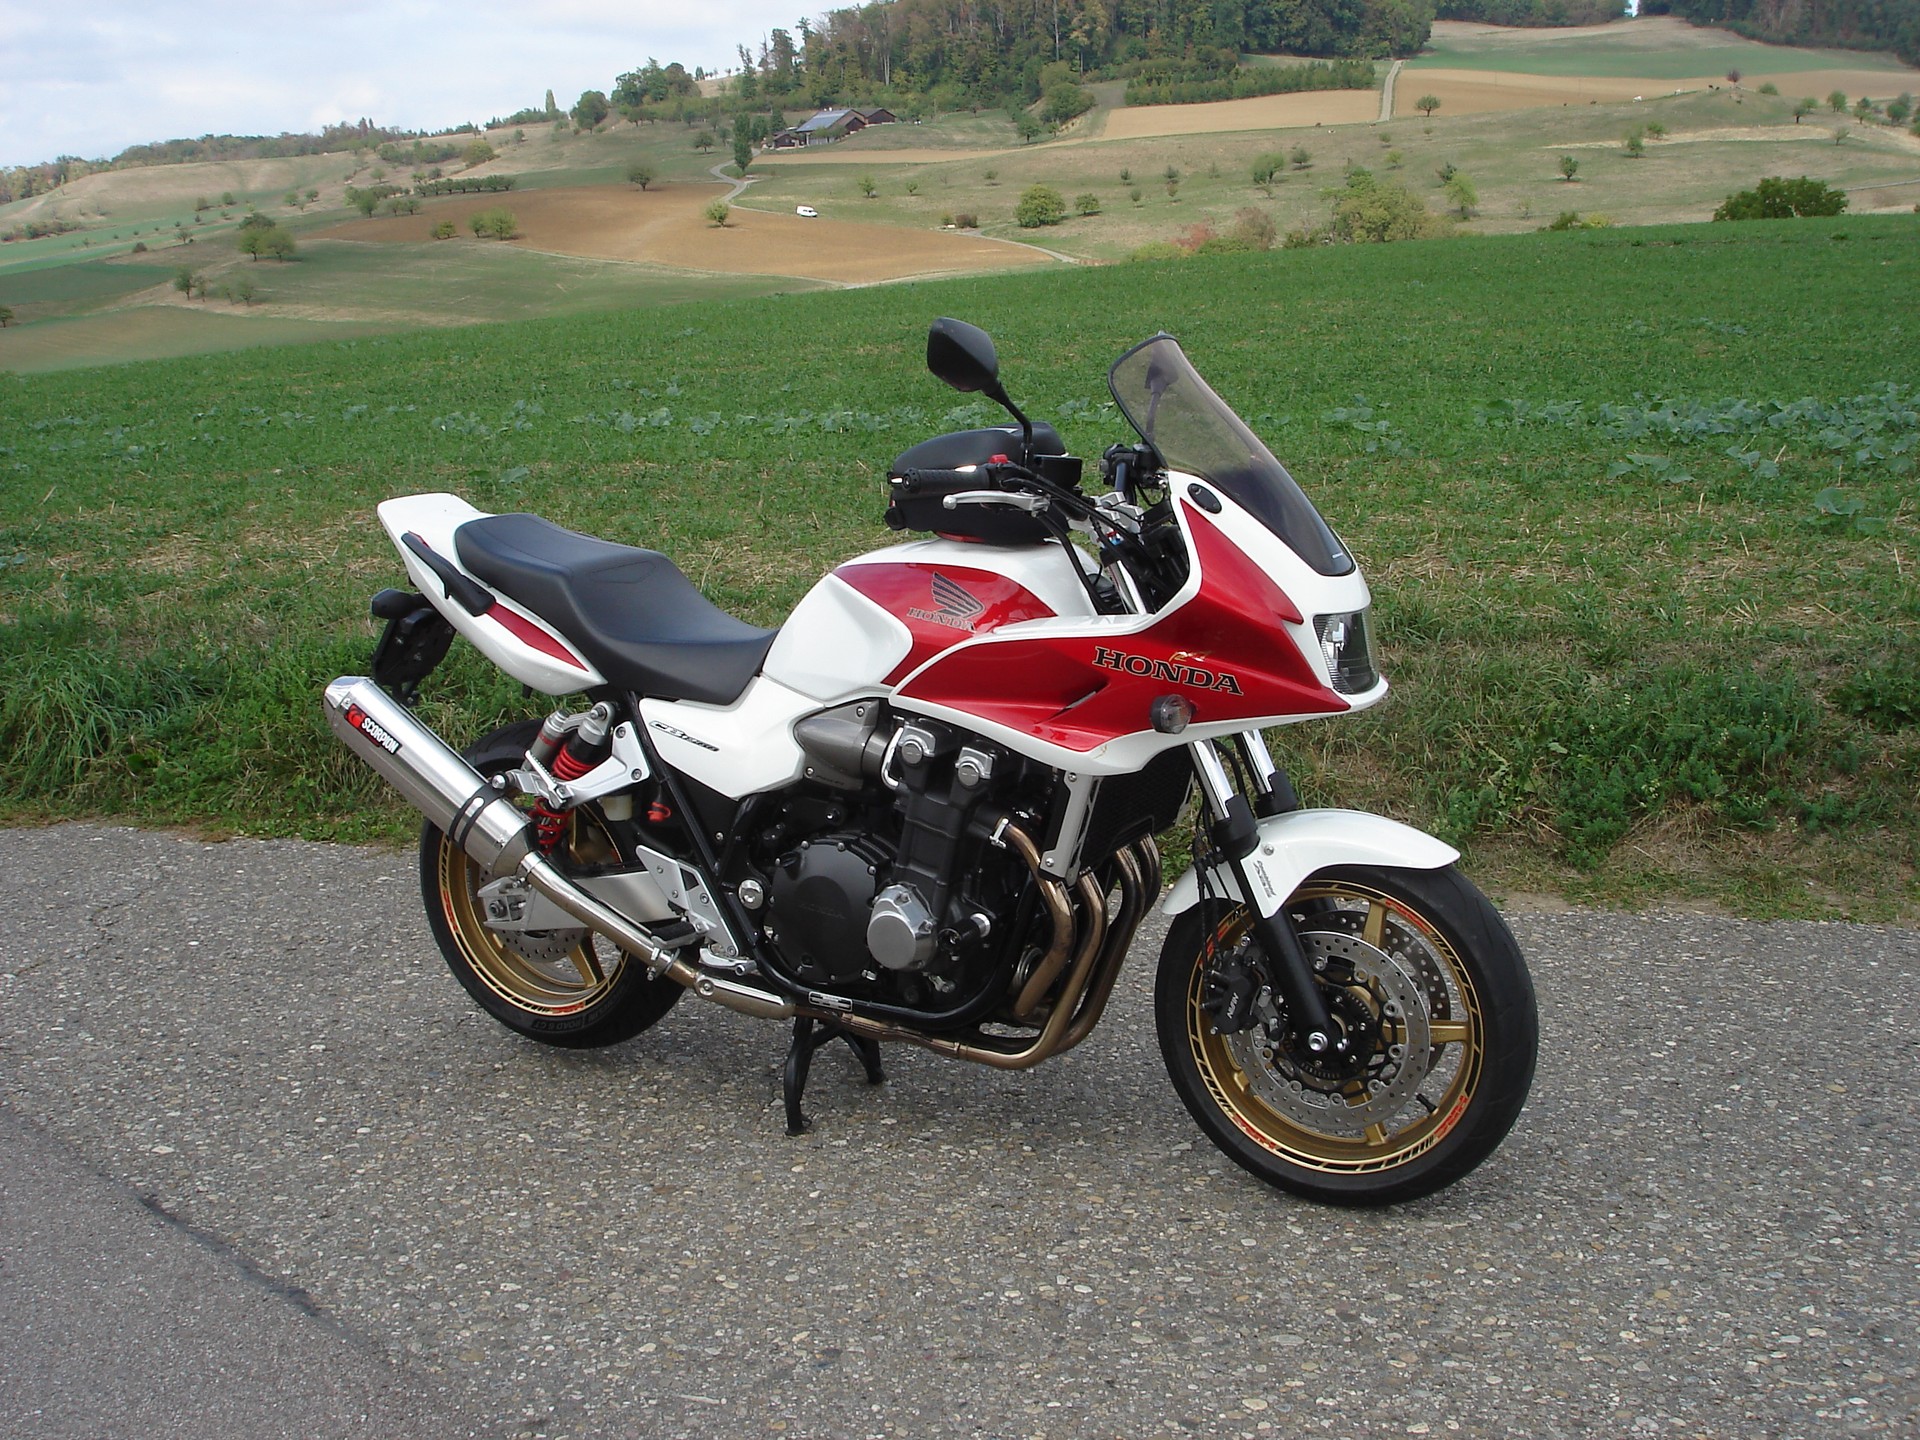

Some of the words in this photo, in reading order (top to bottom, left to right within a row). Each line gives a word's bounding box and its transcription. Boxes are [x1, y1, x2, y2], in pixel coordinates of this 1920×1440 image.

[906, 606, 977, 634] HONDA
[1092, 646, 1244, 696] HONDA
[361, 717, 400, 754] SCORPION
